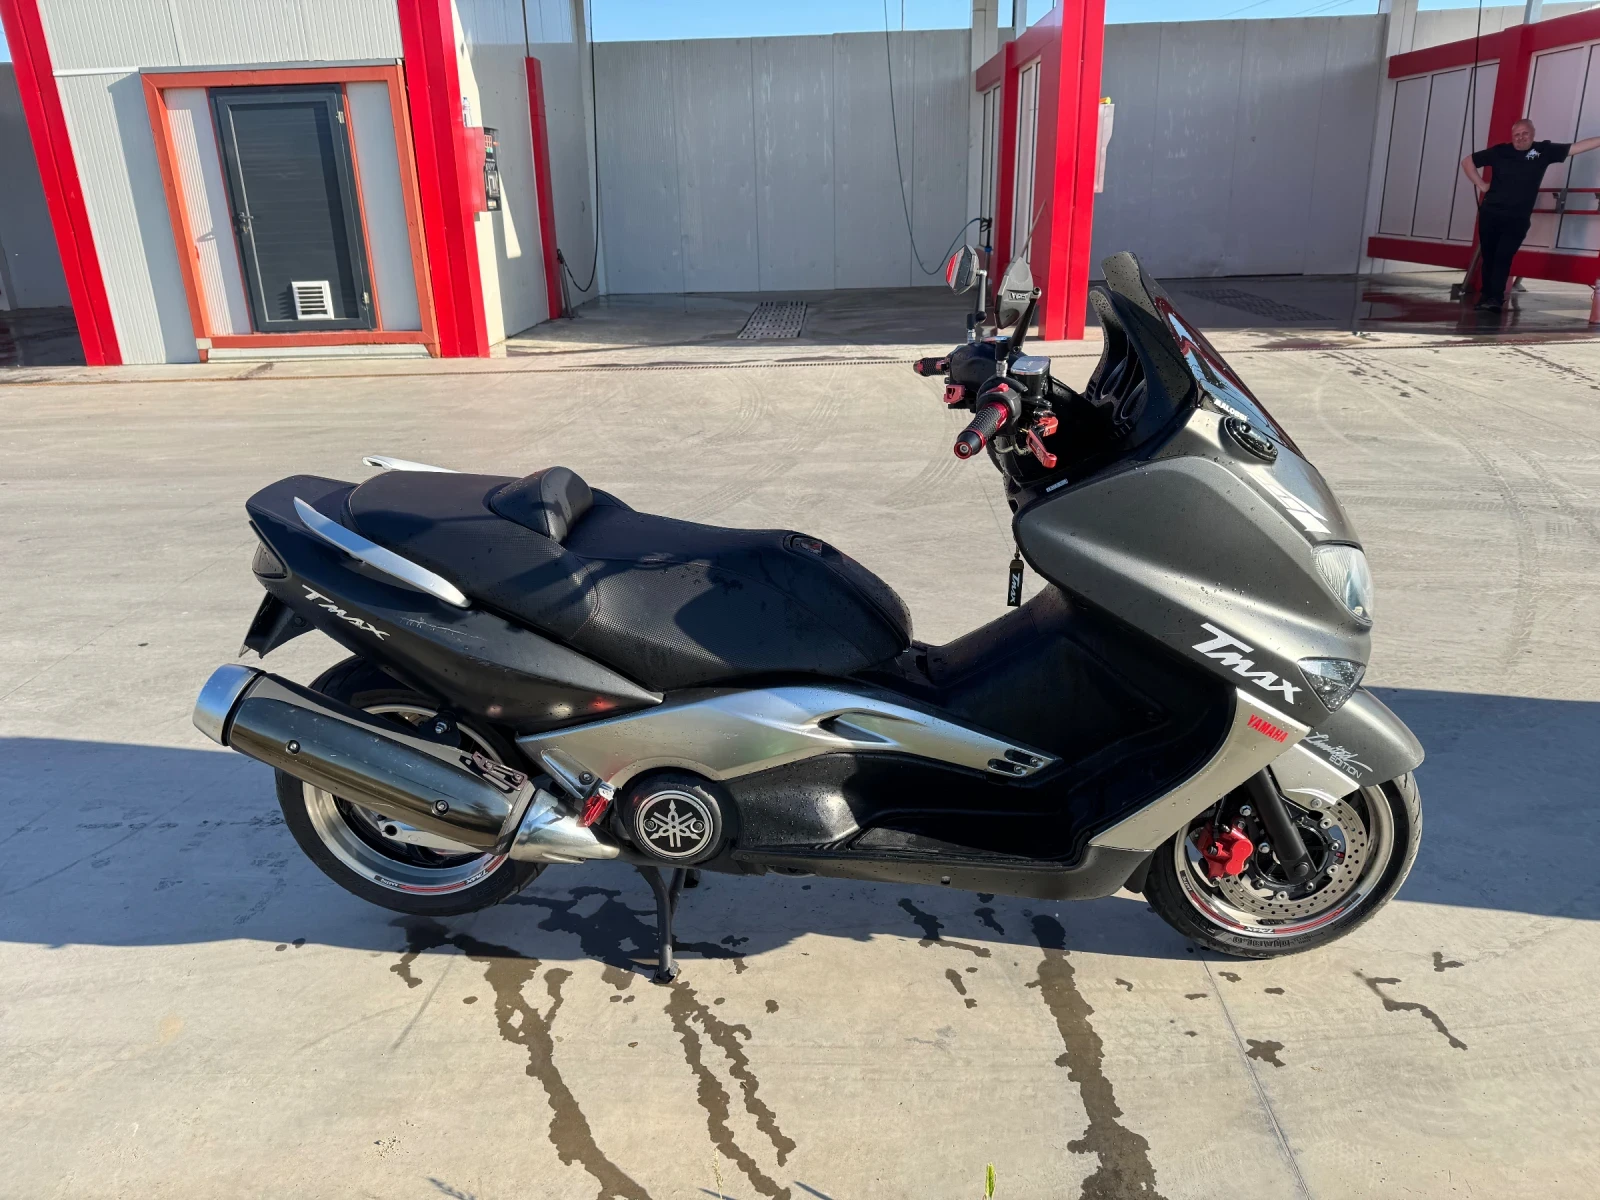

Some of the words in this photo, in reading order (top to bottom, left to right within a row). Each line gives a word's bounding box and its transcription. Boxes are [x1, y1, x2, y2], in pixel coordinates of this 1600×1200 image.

[302, 584, 391, 641] TMAX
[1191, 622, 1303, 704] TMAX
[1246, 713, 1289, 743] YAMAHA
[1328, 754, 1363, 779] EDITION
